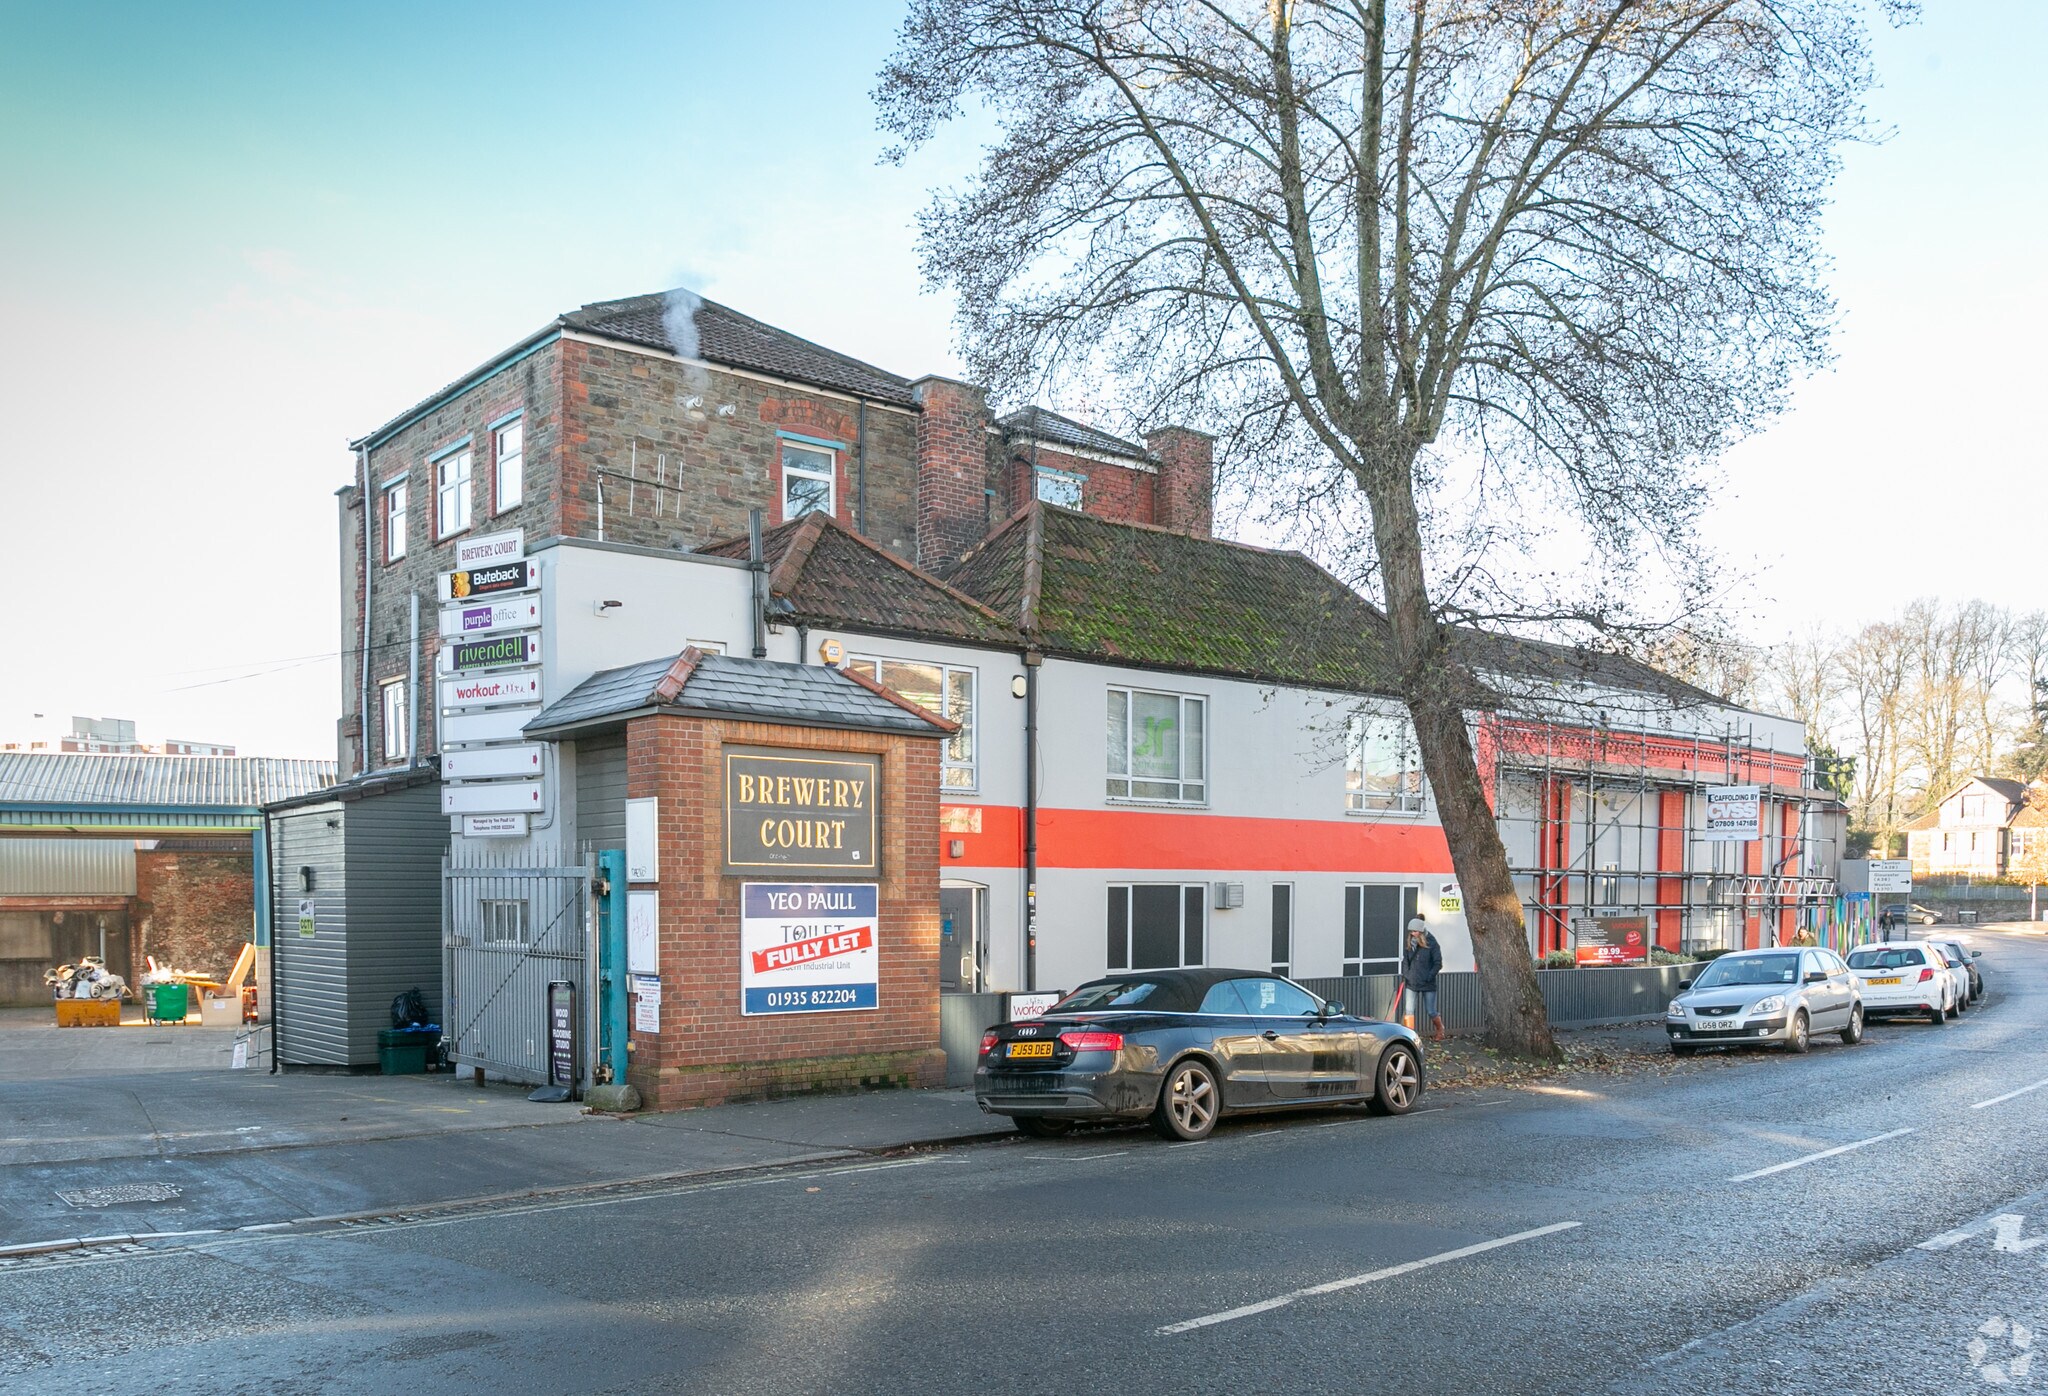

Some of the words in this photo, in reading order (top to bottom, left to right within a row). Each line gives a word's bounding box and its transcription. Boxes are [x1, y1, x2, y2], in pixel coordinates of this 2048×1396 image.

[461, 544, 493, 561] BREWERY
[494, 540, 517, 555] COURT
[473, 567, 519, 585] Byteback
[464, 611, 491, 628] purple
[493, 608, 517, 621] office
[459, 637, 522, 663] rivendell
[456, 682, 501, 699] workout
[448, 760, 453, 769] 6
[738, 774, 865, 808] BREWERY
[449, 796, 453, 805] 7
[1708, 802, 1757, 819] CVSS
[760, 818, 846, 849] COURT
[767, 892, 802, 910] YEO
[807, 892, 856, 910] PAULL
[1440, 898, 1460, 907] CCTV
[300, 918, 313, 930] CCTV
[766, 940, 823, 968] FULLY
[828, 932, 860, 953] LET
[1598, 947, 1620, 955] £9.99
[803, 961, 835, 971] Industrial
[836, 961, 851, 969] Unit
[767, 992, 807, 1007] 01935
[811, 989, 856, 1005] 822204
[555, 1008, 569, 1018] WOOD
[557, 1019, 567, 1028] AND
[552, 1029, 572, 1039] FLOORING
[555, 1040, 570, 1049] STUDIO
[1011, 1044, 1033, 1055] FJ59
[1035, 1044, 1052, 1055] DEB
